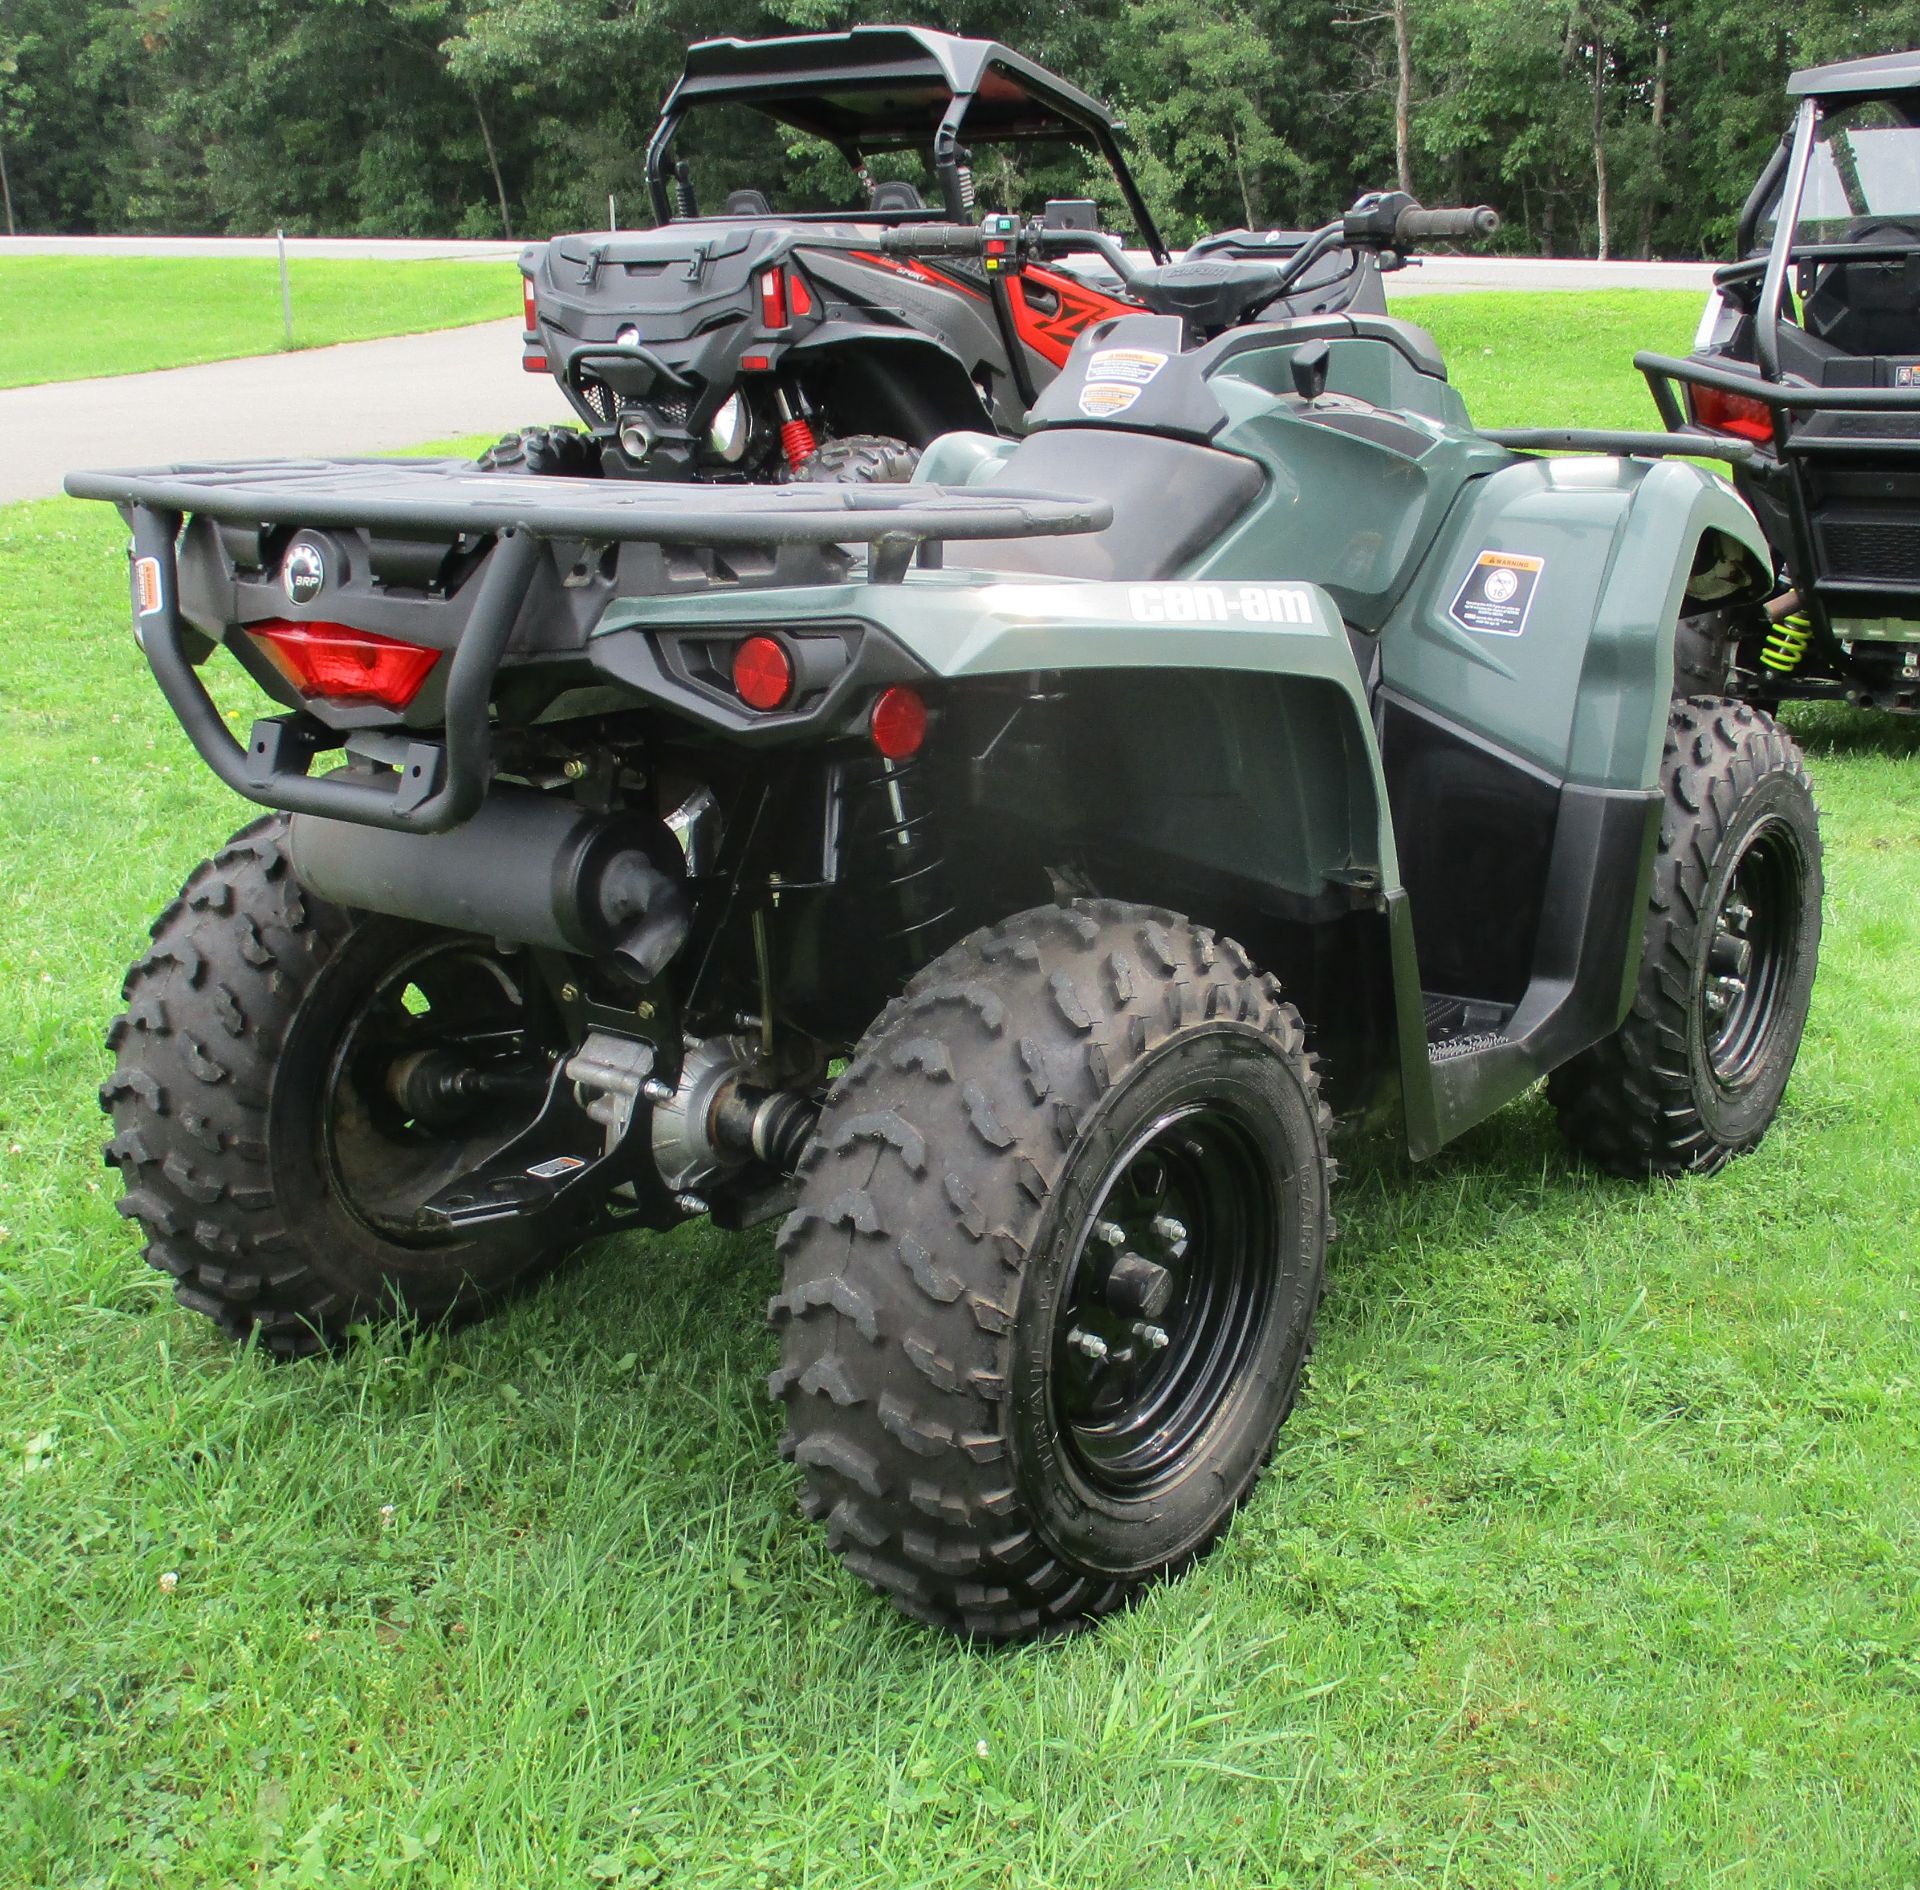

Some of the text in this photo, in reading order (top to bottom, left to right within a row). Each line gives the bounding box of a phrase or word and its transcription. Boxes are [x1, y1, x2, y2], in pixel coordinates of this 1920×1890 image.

[1496, 559, 1530, 568] WARNING
[295, 575, 320, 586] BRP
[1493, 588, 1504, 597] 16
[1128, 586, 1313, 624] can-am
